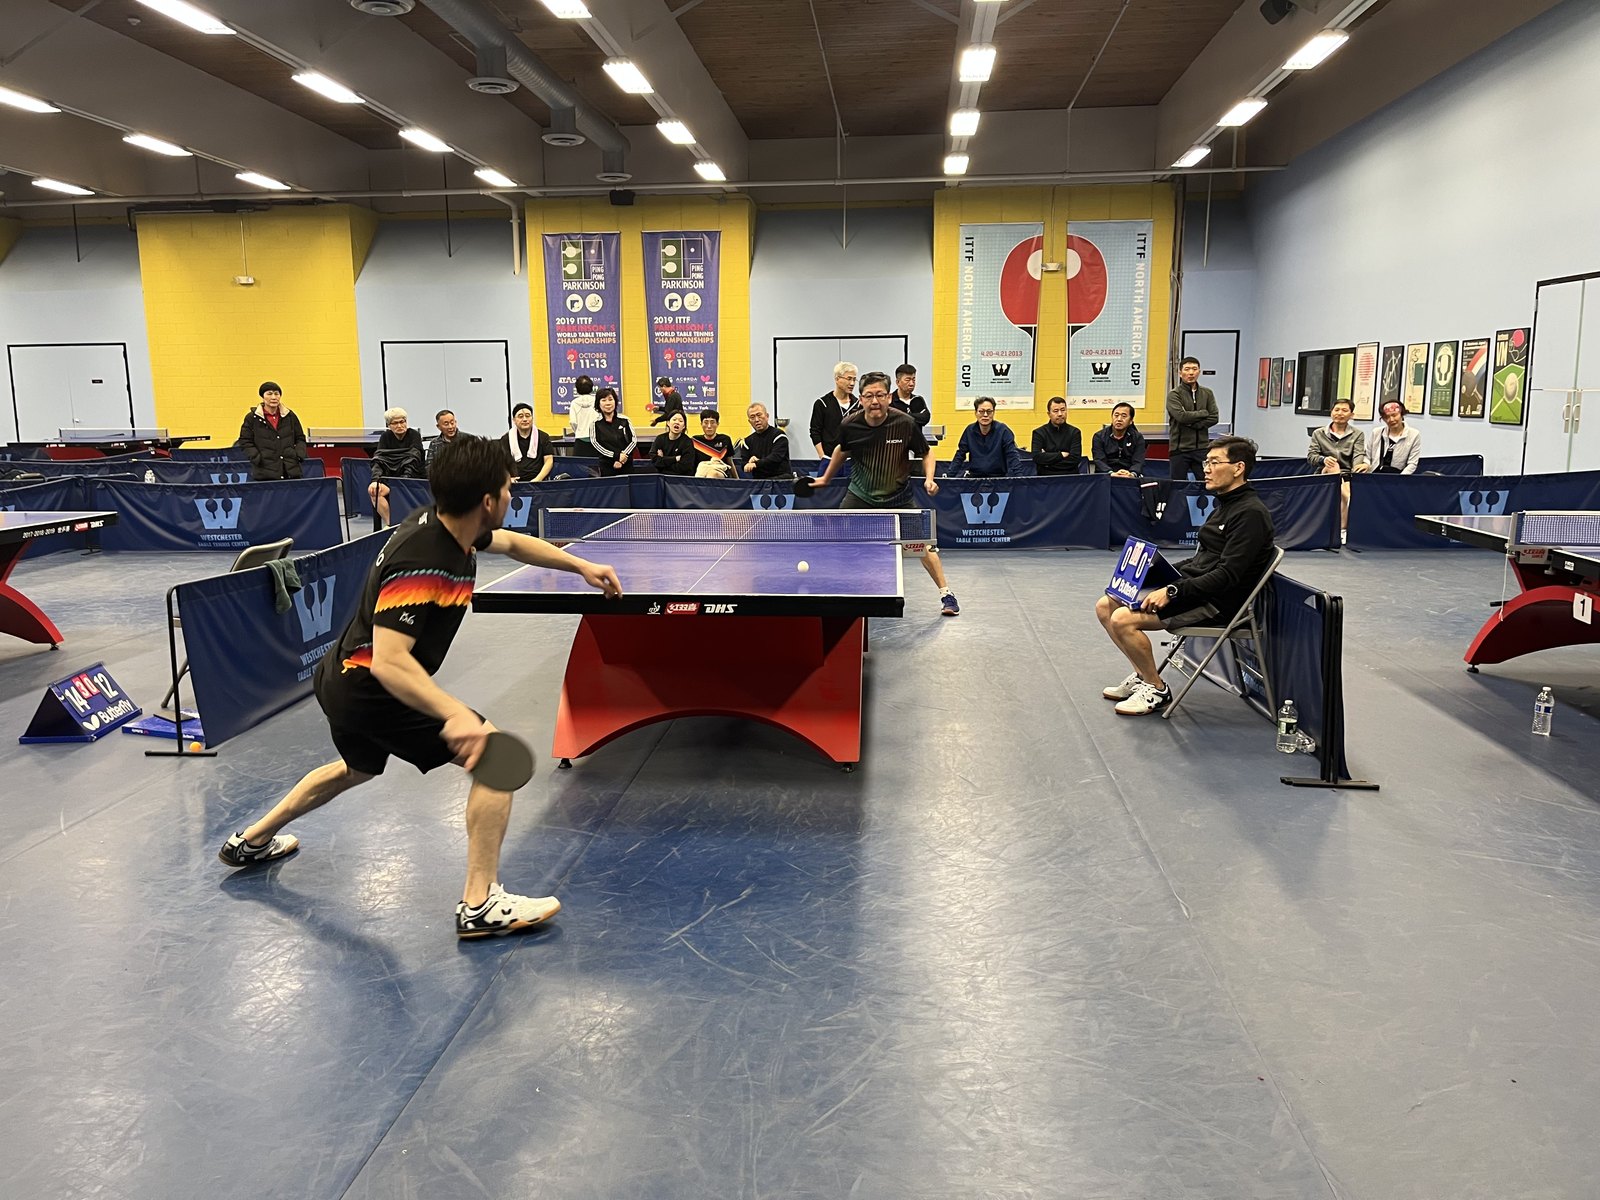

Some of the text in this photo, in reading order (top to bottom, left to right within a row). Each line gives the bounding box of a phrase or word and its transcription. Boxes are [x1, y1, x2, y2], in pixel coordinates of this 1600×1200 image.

[563, 282, 605, 290] PARKINSON
[662, 280, 704, 289] PARKINSON
[962, 236, 974, 387] ITTF NORTH AMERICA CUP
[1131, 233, 1147, 386] ITTF NORTH AMERICA CUP
[580, 360, 607, 368] 11-13
[677, 359, 704, 368] 11-13
[1120, 546, 1132, 572] 0
[1136, 552, 1148, 578] 0
[704, 604, 738, 614] DHS
[1580, 598, 1586, 616] 1
[64, 686, 91, 713] 14
[94, 672, 119, 698] 12
[98, 699, 134, 723] Butterfly
